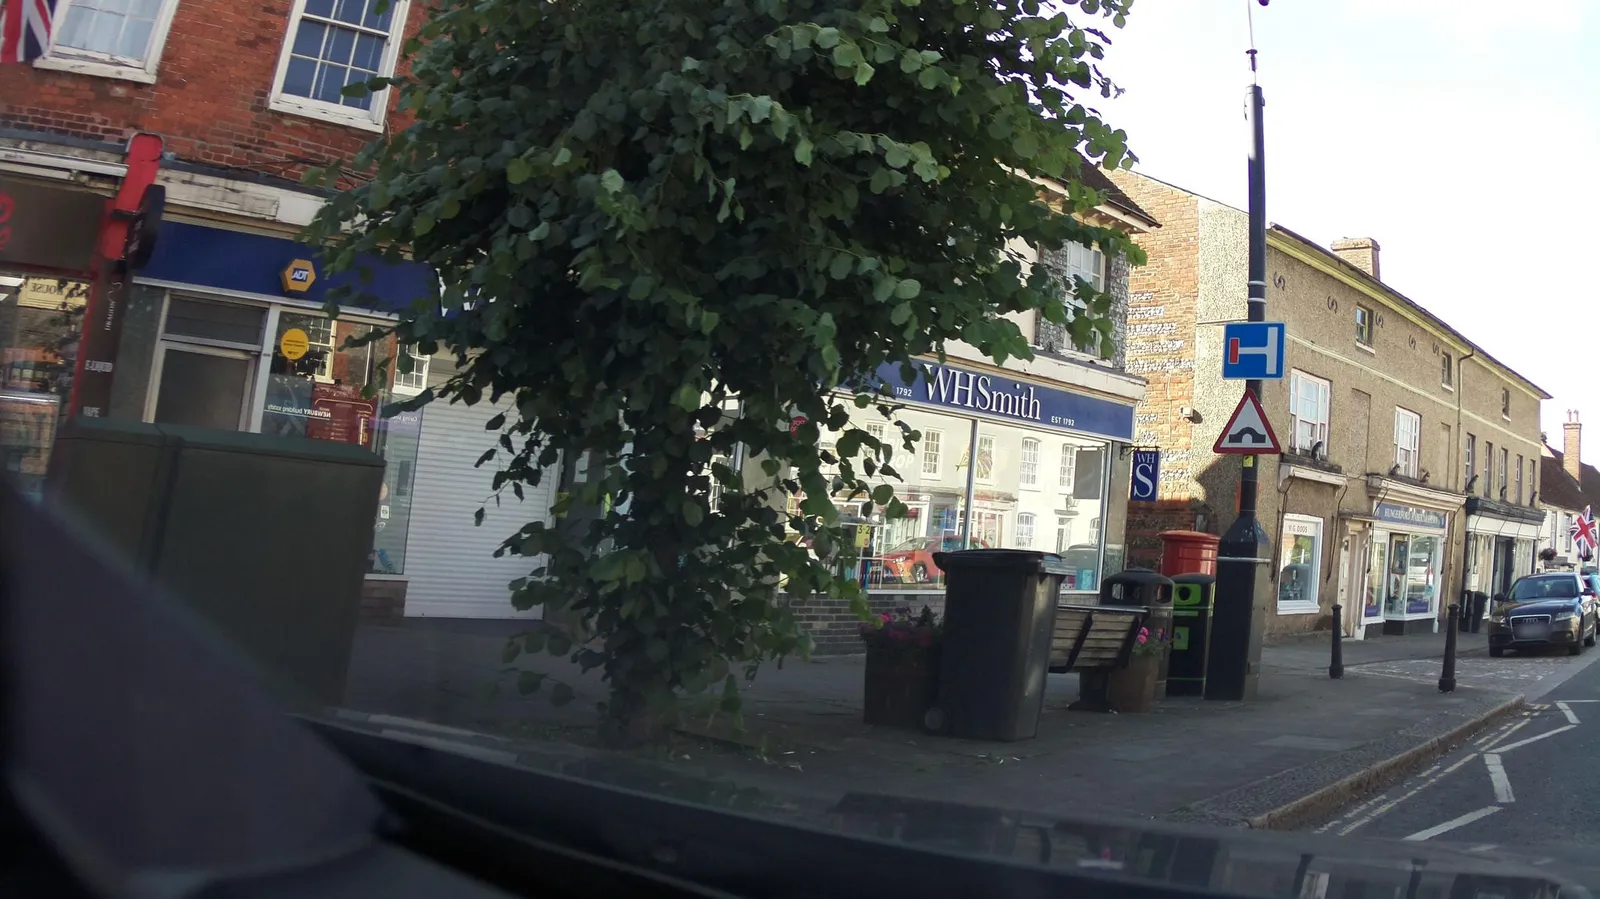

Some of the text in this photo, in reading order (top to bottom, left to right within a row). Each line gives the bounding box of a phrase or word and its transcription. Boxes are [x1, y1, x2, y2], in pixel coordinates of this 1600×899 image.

[291, 270, 309, 281] ADT
[896, 386, 912, 397] 1792
[922, 363, 1042, 420] WHSmith
[1051, 415, 1075, 426] EST 1792
[1137, 453, 1155, 464] WH
[1133, 463, 1153, 498] S
